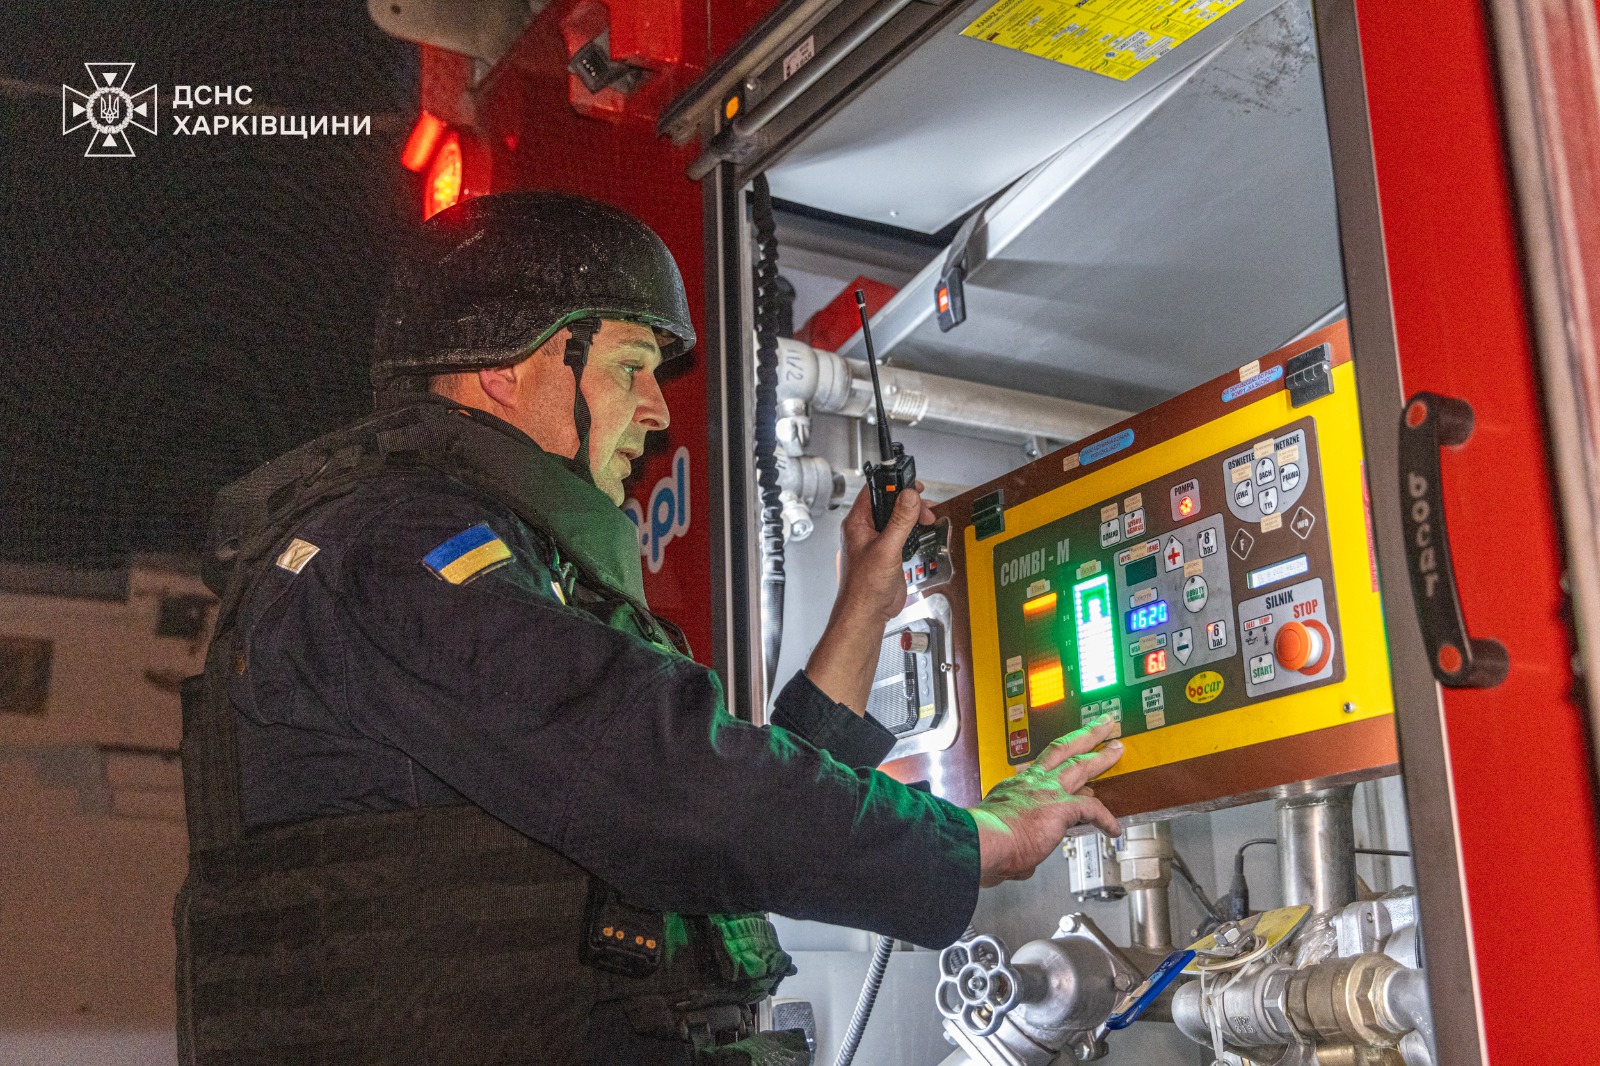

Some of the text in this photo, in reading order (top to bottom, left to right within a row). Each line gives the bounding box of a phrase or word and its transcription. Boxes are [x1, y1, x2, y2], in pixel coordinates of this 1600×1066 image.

[1228, 452, 1254, 470] OŚWIETLE
[1258, 468, 1272, 481] DACH
[1174, 481, 1195, 497] POMPA
[1235, 489, 1249, 501] LEWA
[1296, 518, 1309, 530] INFO
[1204, 531, 1210, 545] 8
[1408, 472, 1439, 598] bocar
[1202, 545, 1214, 556] bar
[1239, 538, 1245, 551] F
[1000, 547, 1046, 587] COMBI
[1056, 538, 1070, 566] M
[1265, 589, 1294, 610] SILNIK
[1131, 602, 1168, 630] 1620
[1292, 599, 1318, 619] STOP
[1213, 623, 1220, 637] 6
[1212, 638, 1223, 648] bar
[1252, 664, 1273, 679] START
[1188, 680, 1222, 698] bocar
